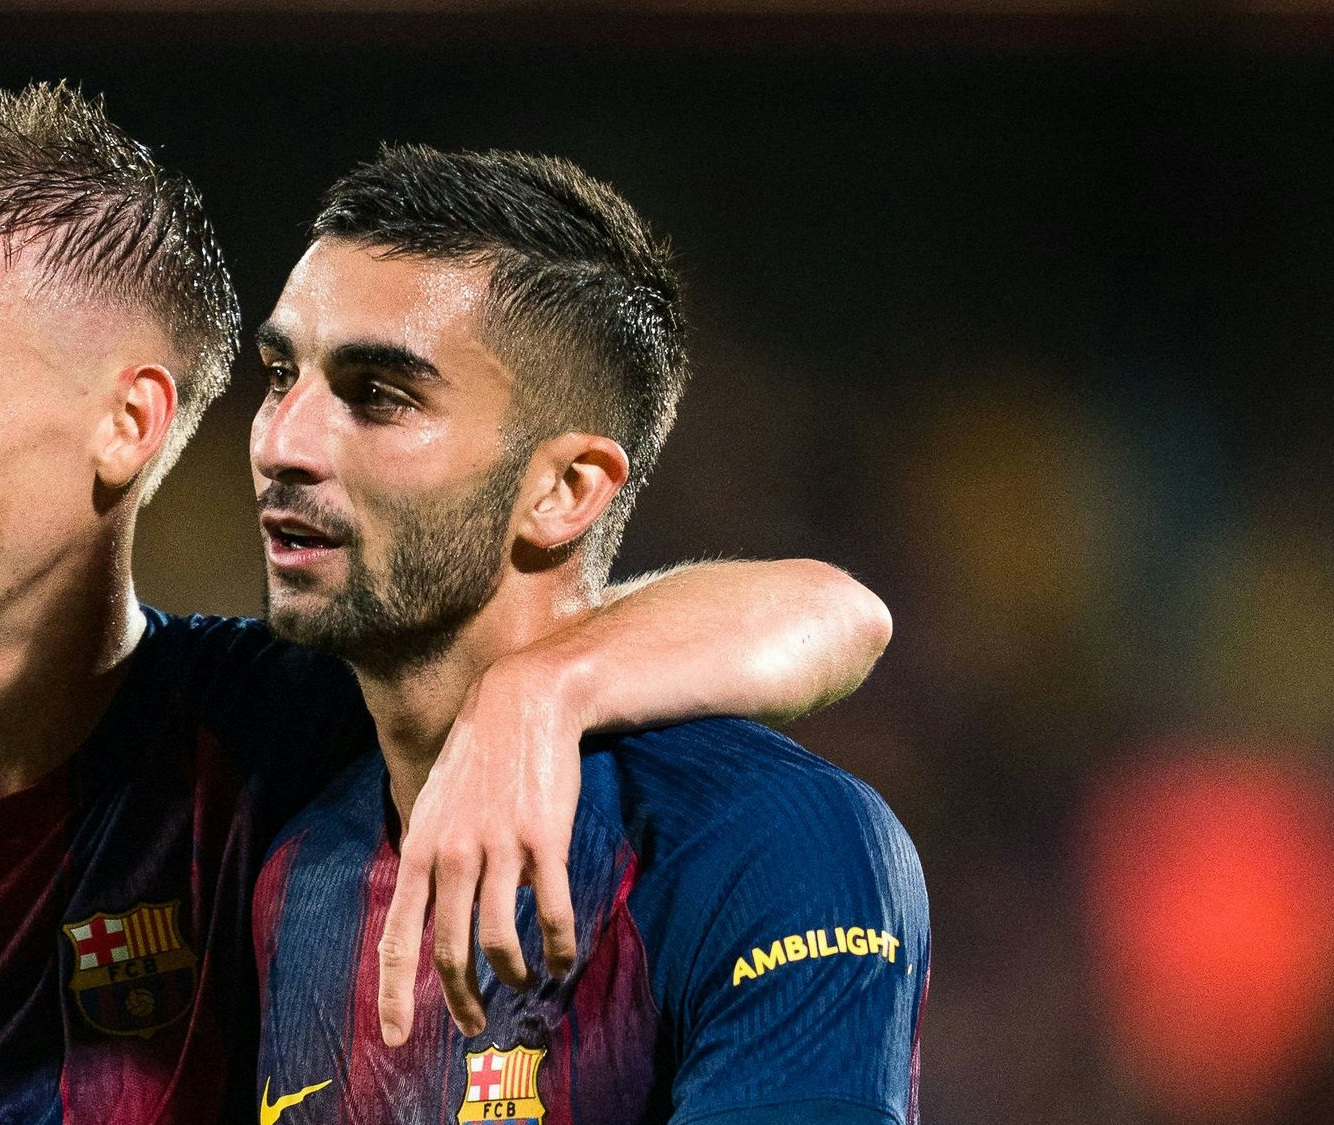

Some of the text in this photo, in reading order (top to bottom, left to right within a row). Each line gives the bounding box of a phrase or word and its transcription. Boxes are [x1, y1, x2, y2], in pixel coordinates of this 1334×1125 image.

[732, 926, 900, 987] AMBILIGHT
[107, 958, 158, 981] FCB
[483, 1101, 516, 1119] FCB
